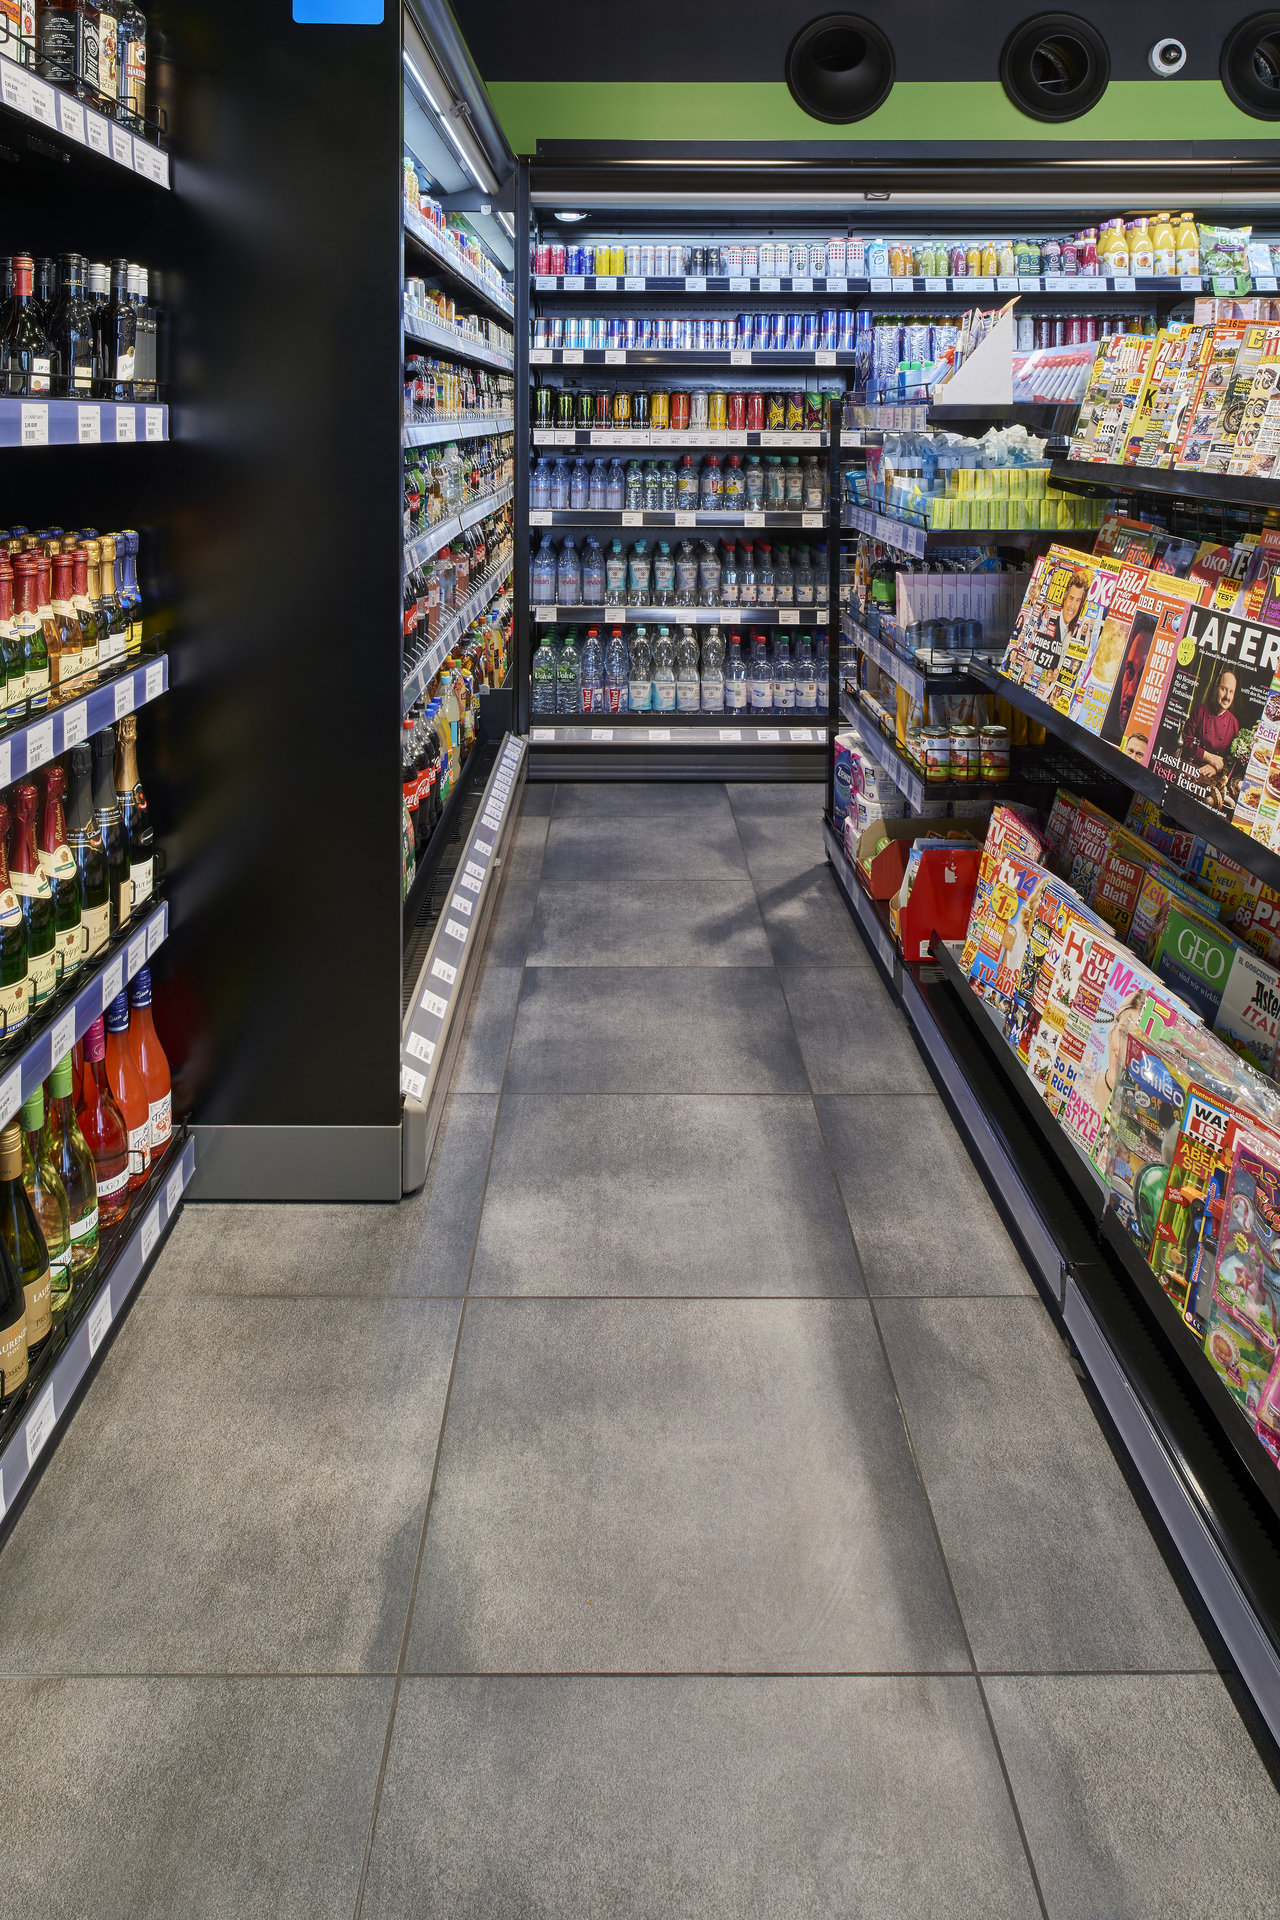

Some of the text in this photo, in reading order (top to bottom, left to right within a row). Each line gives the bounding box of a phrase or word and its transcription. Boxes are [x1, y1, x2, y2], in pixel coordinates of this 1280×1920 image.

[1228, 319, 1237, 328] 16
[1107, 561, 1120, 573] neuen
[1087, 575, 1118, 606] OK!
[1117, 569, 1148, 594] Bild
[1220, 578, 1241, 593] NEU
[1111, 590, 1139, 616] Frau
[1121, 591, 1132, 600] der
[1140, 595, 1158, 612] DER
[1155, 638, 1174, 659] WAS
[1186, 610, 1280, 671] LAFER
[1038, 652, 1054, 670] 57!
[1149, 653, 1167, 674] DER
[1236, 660, 1257, 673] Geschmack
[535, 671, 554, 681] Volvic
[1182, 676, 1200, 688] Rezepte
[1152, 760, 1177, 783] Feste
[1182, 764, 1201, 779] uns
[1109, 856, 1136, 880] Mein
[1215, 874, 1237, 888] NEU!
[1102, 884, 1129, 907] Blatt
[1114, 908, 1129, 926] 79
[1235, 906, 1251, 927] 68
[968, 940, 977, 950] Die
[1254, 930, 1270, 946] NUR
[1177, 928, 1225, 979] GEO
[996, 962, 1012, 979] DER
[1178, 970, 1191, 985] sind
[1054, 1055, 1065, 1070] So
[1191, 1087, 1226, 1110] Kunterbunt
[1224, 1106, 1236, 1116] mit
[1065, 1102, 1099, 1143] STYLE
[1198, 1121, 1225, 1144] IST
[1182, 1155, 1212, 1181] SET
[1158, 1224, 1170, 1236] Lupe
